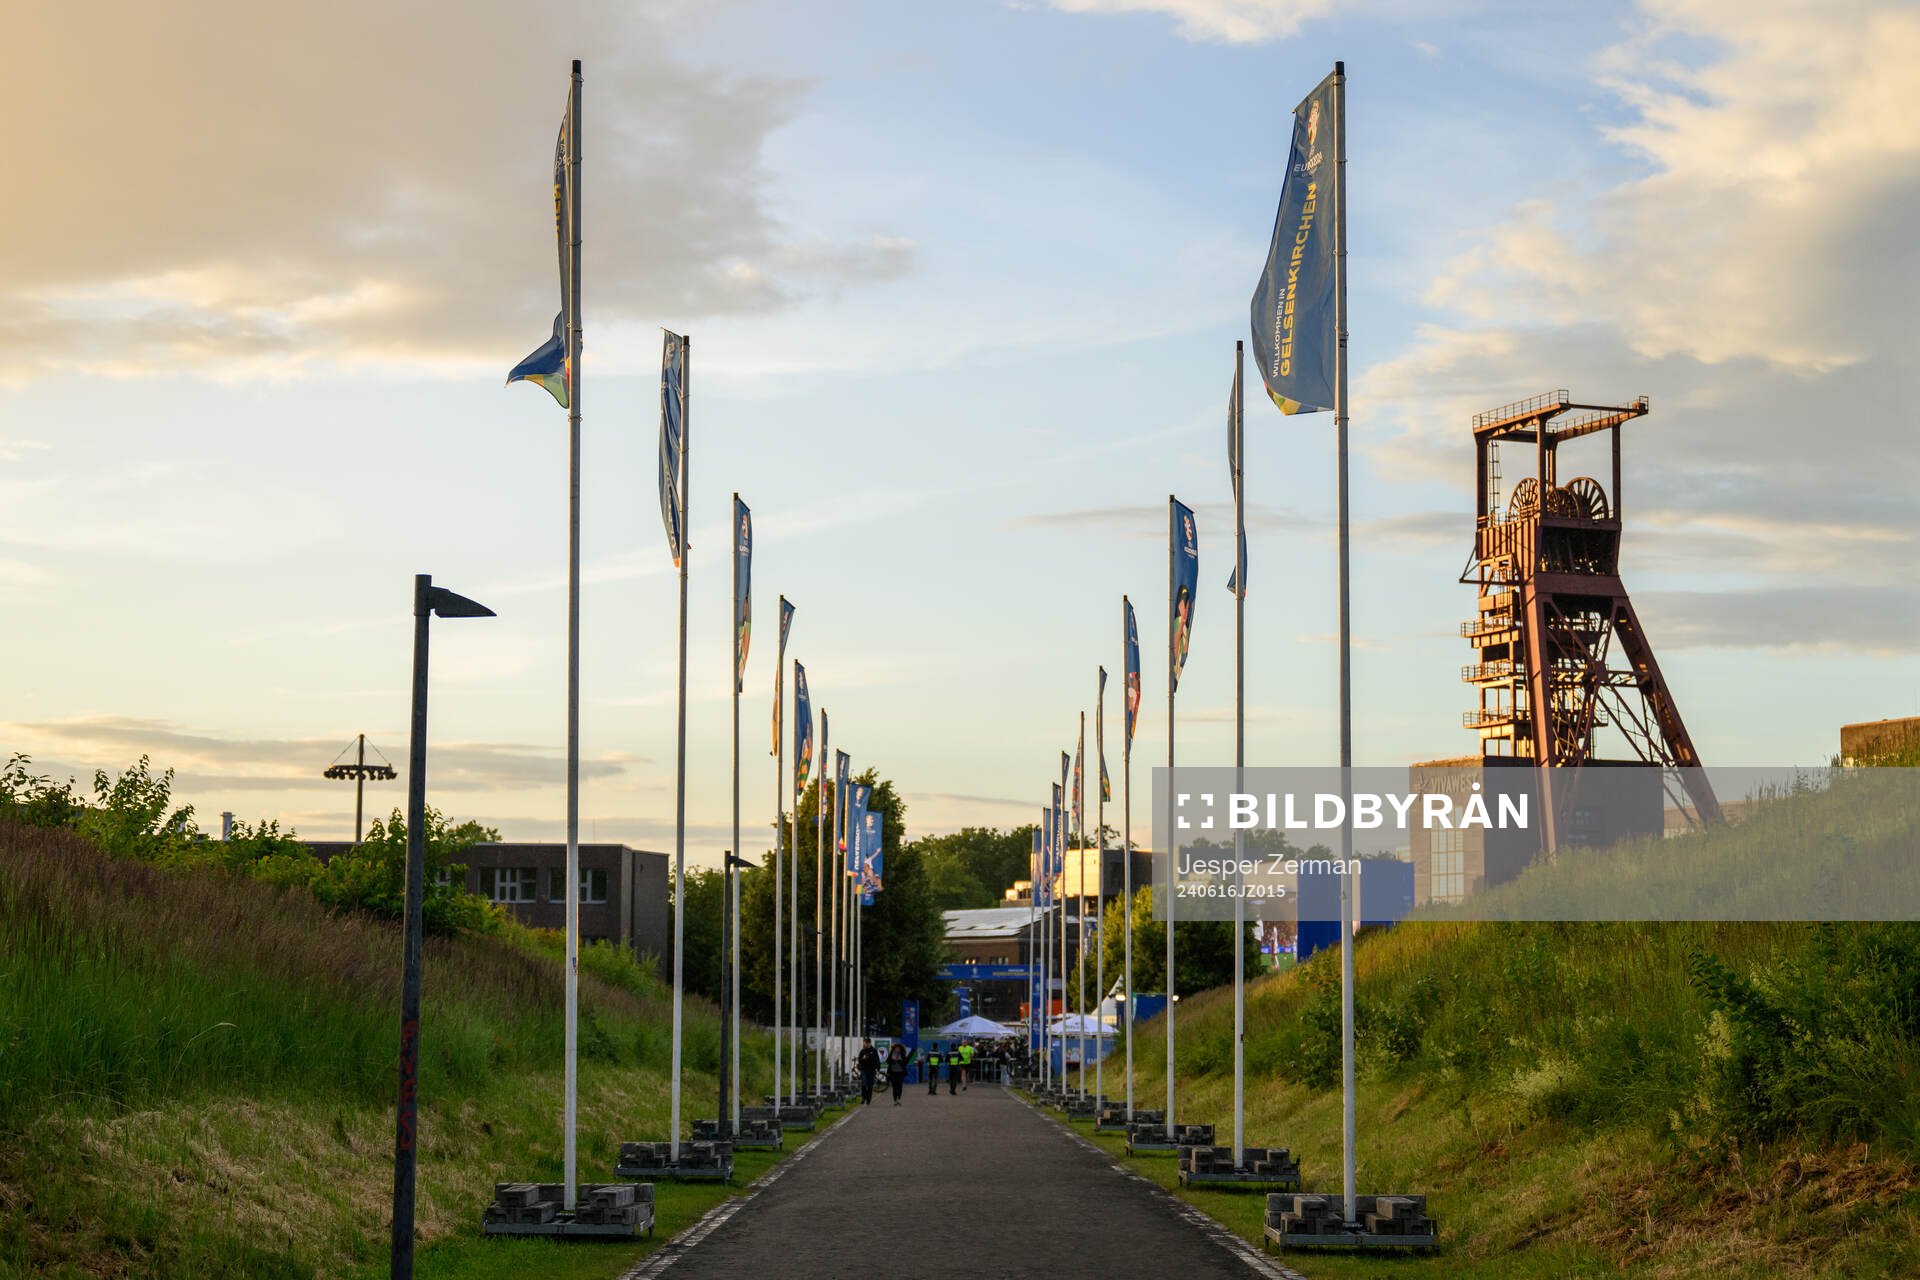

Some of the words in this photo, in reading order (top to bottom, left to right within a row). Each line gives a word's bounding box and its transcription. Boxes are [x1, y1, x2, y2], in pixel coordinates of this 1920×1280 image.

[1280, 182, 1317, 377] GELSENKIRCHEN
[1272, 301, 1284, 378] WILLKOMMEN
[1278, 287, 1286, 300] IN
[1430, 771, 1479, 795] VIVAWEST
